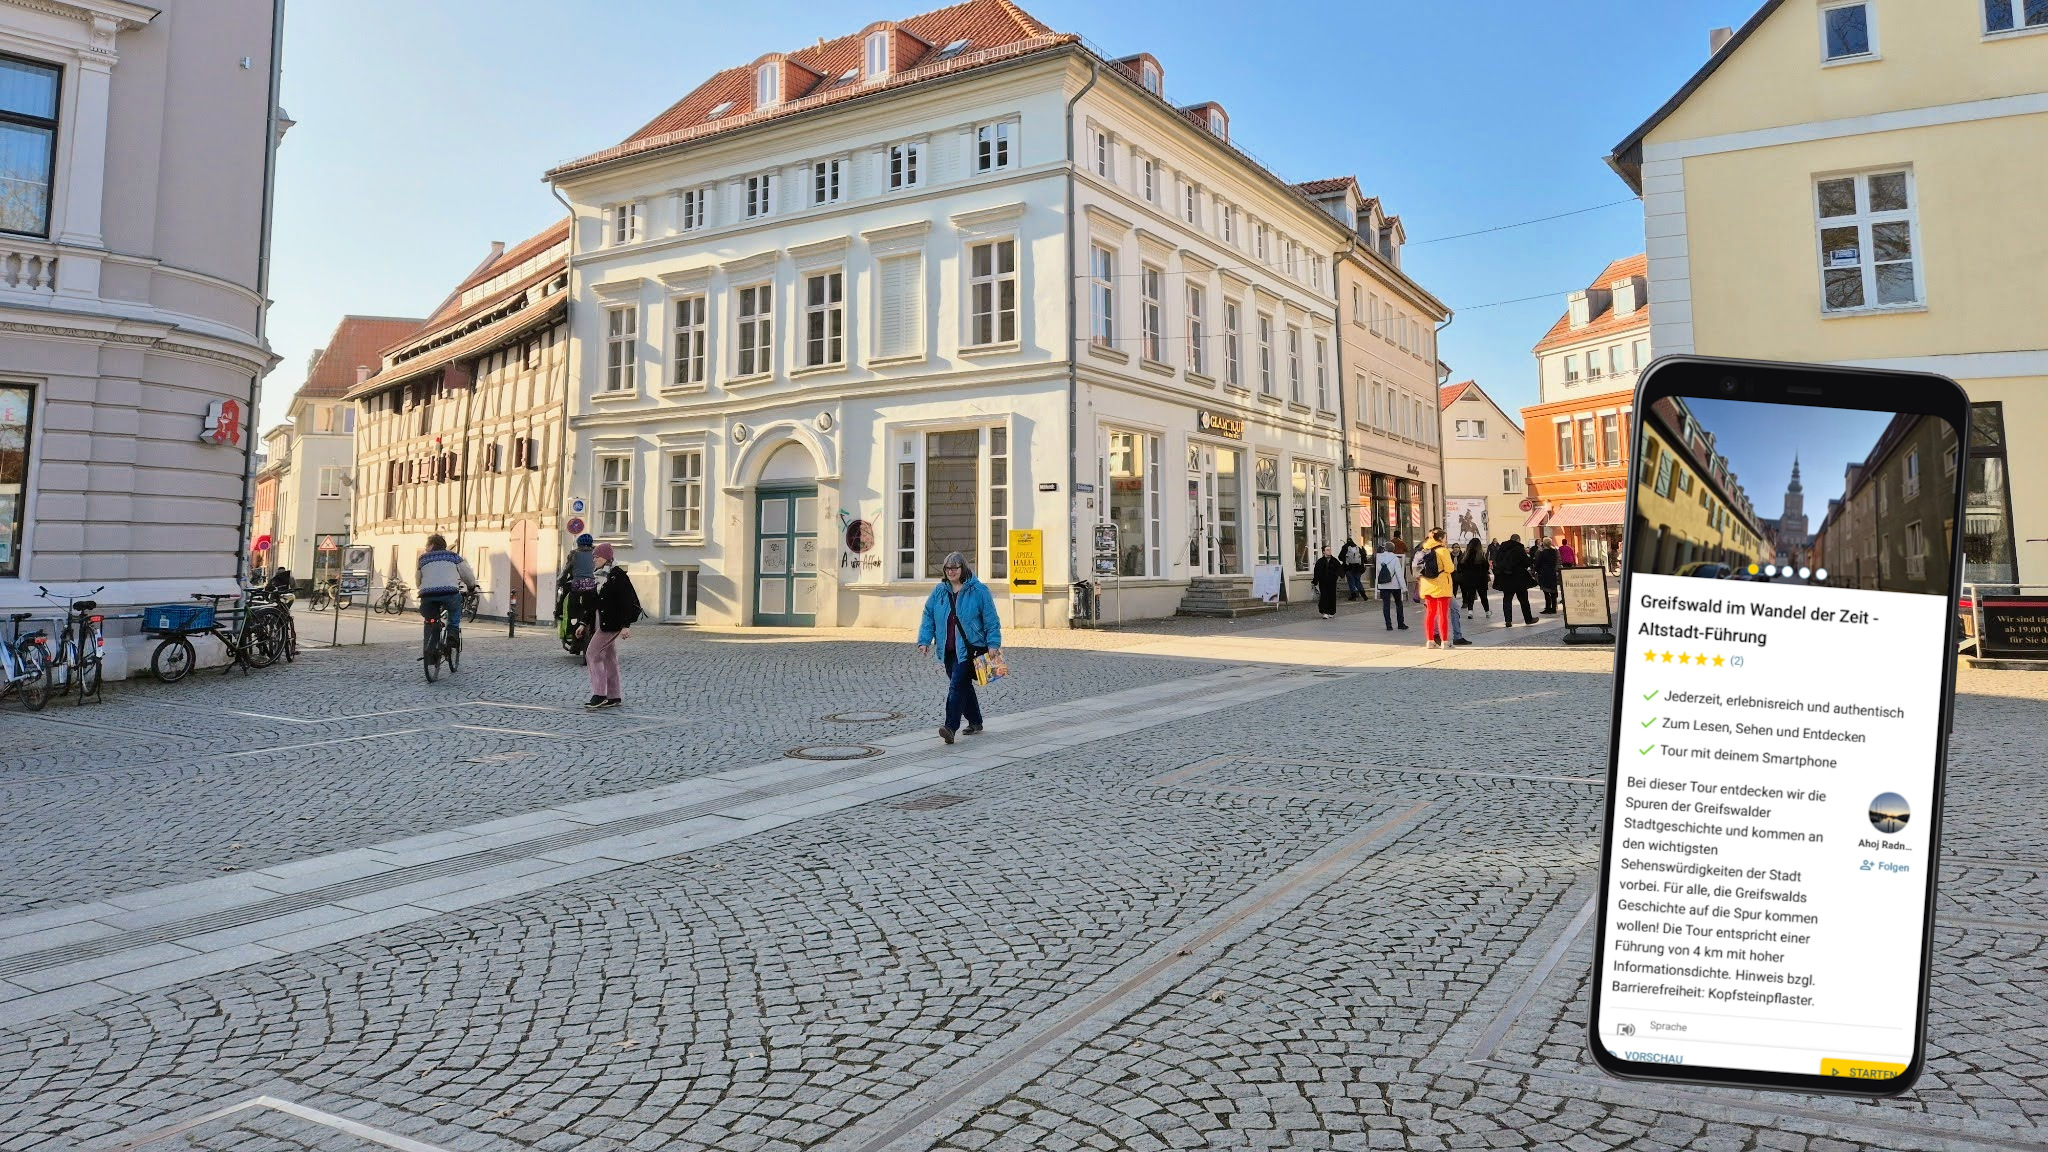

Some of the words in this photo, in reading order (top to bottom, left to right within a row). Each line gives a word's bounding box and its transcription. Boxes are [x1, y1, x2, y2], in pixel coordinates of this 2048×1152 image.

[1641, 594, 1722, 613] Greifswald
[1726, 600, 1745, 615] im
[1750, 602, 1806, 620] Wandel
[1810, 607, 1836, 622] der
[1839, 609, 1869, 625] Zeit
[1638, 622, 1767, 647] Altstadt-Führung
[1730, 655, 1744, 667] (2)
[1664, 690, 1722, 706] Jederzeit,
[1726, 695, 1804, 711] erlebnisreich
[1807, 702, 1830, 713] und
[1833, 704, 1904, 718] authentisch
[1662, 717, 1690, 730] Zum
[1693, 720, 1732, 734] Lesen,
[1735, 723, 1773, 736] Sehen
[1776, 727, 1799, 738] und
[1803, 728, 1866, 743] Entdecken
[1661, 744, 1688, 757] Tour
[1691, 748, 1710, 759] mit
[1714, 749, 1759, 762] deinem
[1762, 752, 1837, 768] Smartphone
[1627, 776, 1646, 788] Bei
[1649, 778, 1687, 791] dieser
[1690, 781, 1717, 793] Tour
[1720, 785, 1783, 798] entdecken
[1787, 789, 1805, 800] wir
[1808, 790, 1826, 802] die
[1625, 797, 1668, 810] Spuren
[1671, 800, 1691, 812] der
[1694, 802, 1771, 818] Greifswalder
[1624, 817, 1722, 835] Stadtgeschichte
[1726, 826, 1748, 837] und
[1752, 826, 1805, 841] kommen
[1808, 833, 1823, 842] an
[1622, 838, 1645, 850] den
[1648, 840, 1718, 856] wichtigsten
[1858, 839, 1879, 851] Ahoj
[1621, 858, 1743, 878] Sehenswürdigkeiten
[1746, 867, 1766, 879] der
[1769, 869, 1801, 882] Stadt
[1879, 862, 1909, 873] Folgen
[1619, 880, 1659, 892] vorbei.
[1664, 882, 1684, 893] Für
[1686, 884, 1710, 897] alle,
[1713, 885, 1732, 897] die
[1735, 887, 1807, 903] Greifswalds
[1618, 899, 1686, 914] Geschichte
[1689, 905, 1709, 916] auf
[1712, 906, 1730, 918] die
[1734, 907, 1762, 921] Spur
[1765, 910, 1818, 924] kommen
[1616, 920, 1659, 933] wollen!
[1663, 923, 1682, 935] Die
[1686, 924, 1713, 937] Tour
[1716, 929, 1777, 942] entspricht
[1780, 932, 1810, 944] einer
[1615, 940, 1664, 957] Führung
[1668, 946, 1690, 956] von
[1693, 946, 1701, 956] 4
[1704, 946, 1723, 958] km
[1727, 949, 1746, 960] mit
[1749, 949, 1784, 963] hoher
[1614, 960, 1731, 979] Informationsdichte.
[1736, 969, 1784, 983] Hinweis
[1787, 973, 1815, 988] bzgl.
[1612, 980, 1705, 998] Barrierefreiheit:
[1708, 988, 1814, 1006] Kopfsteinpflaster.
[1650, 1020, 1688, 1032] Sprache
[1625, 1051, 1683, 1064] VORSCHAU
[1849, 1067, 1898, 1079] STARTEN
